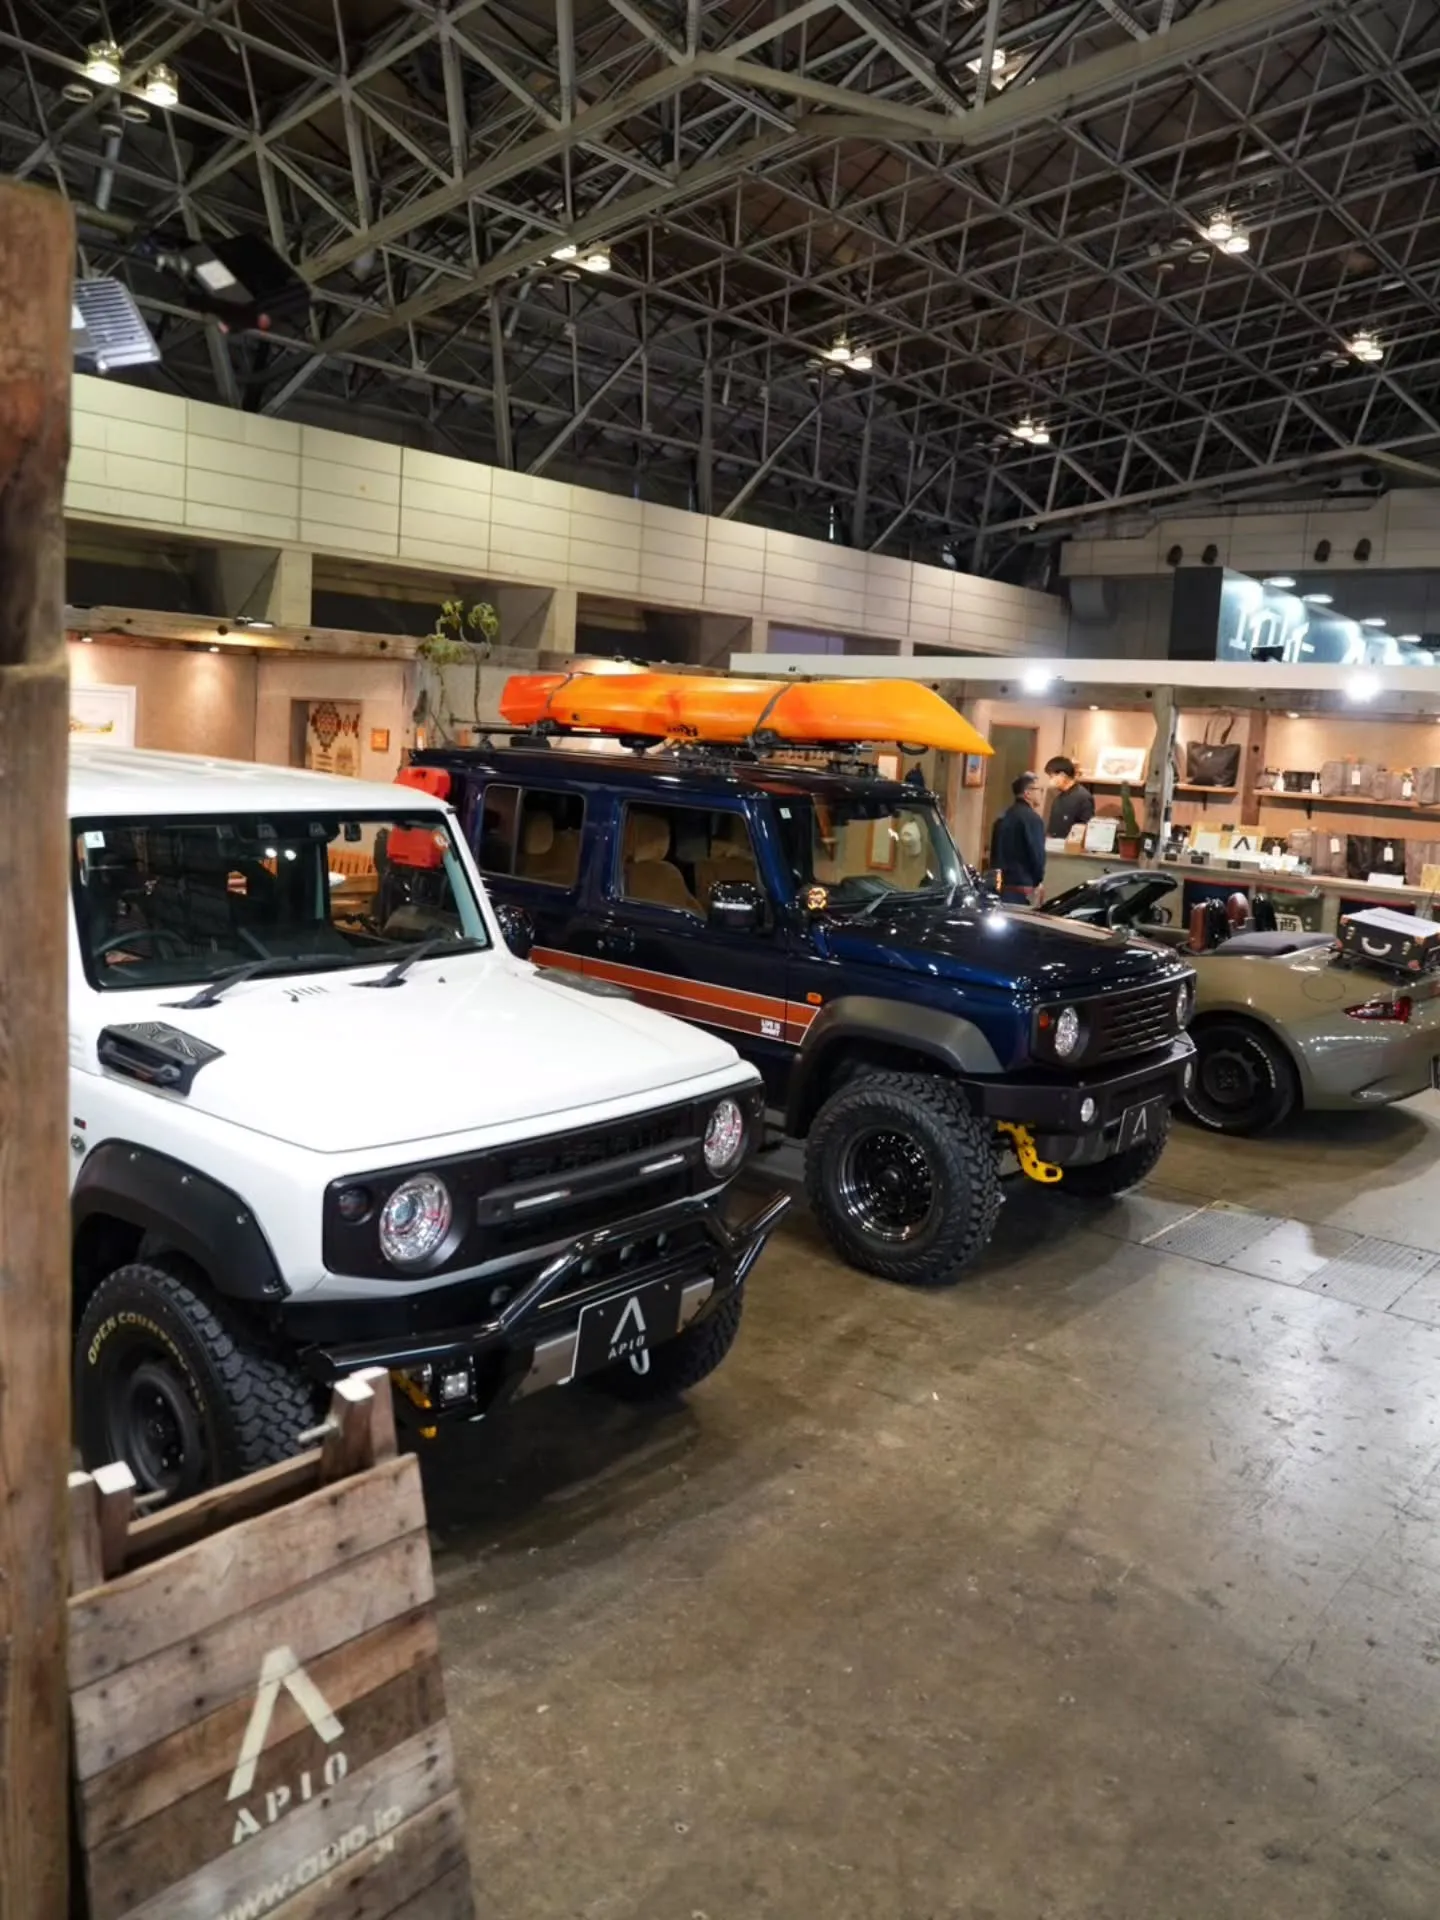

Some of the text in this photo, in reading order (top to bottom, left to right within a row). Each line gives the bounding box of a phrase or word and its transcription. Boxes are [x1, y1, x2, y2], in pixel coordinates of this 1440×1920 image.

[88, 1316, 117, 1365] OPEN
[607, 1335, 645, 1360] APIO
[232, 1752, 347, 1844] APIO
